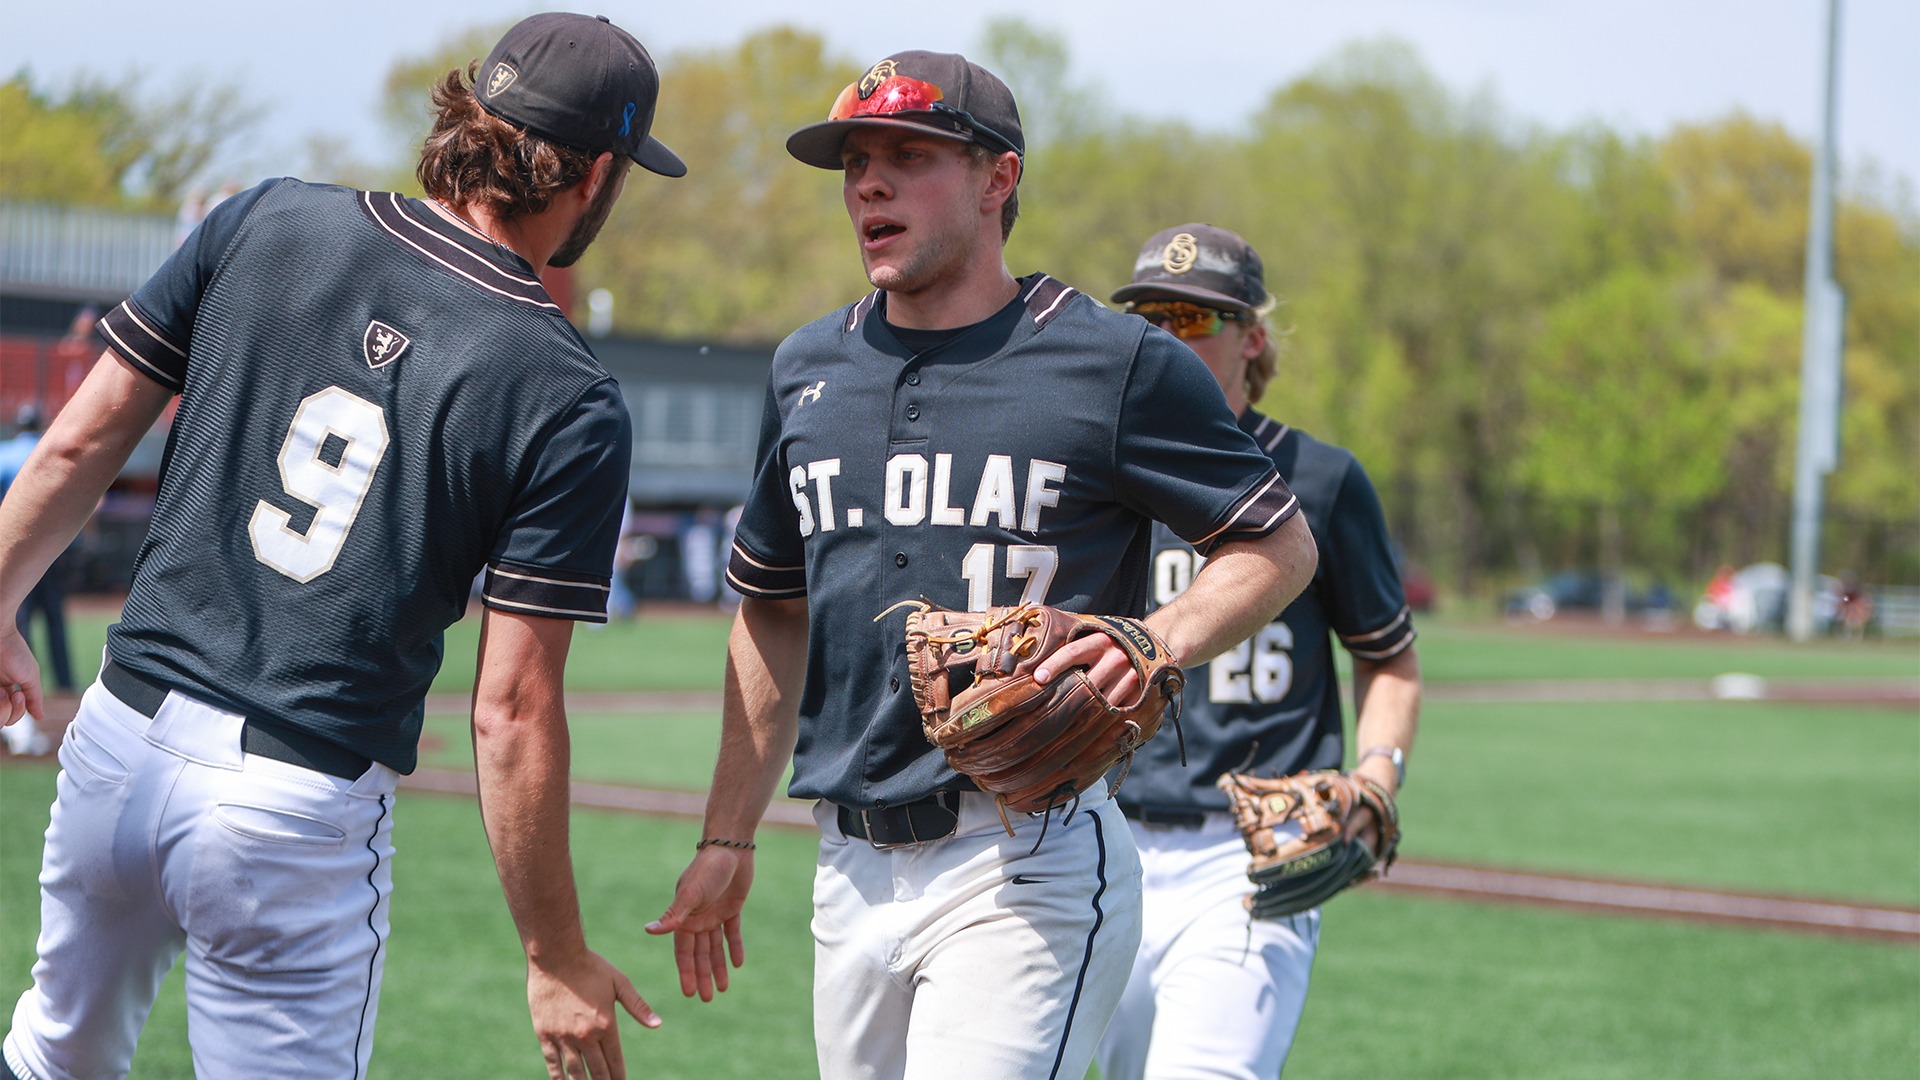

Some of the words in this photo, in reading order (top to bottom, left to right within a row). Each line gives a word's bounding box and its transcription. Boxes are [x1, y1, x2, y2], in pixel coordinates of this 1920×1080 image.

[248, 385, 390, 584] 9
[790, 458, 863, 536] ST.
[884, 453, 1066, 536] OLAF
[962, 543, 1059, 613] 17
[1209, 621, 1294, 703] 26
[962, 701, 992, 730] A2K
